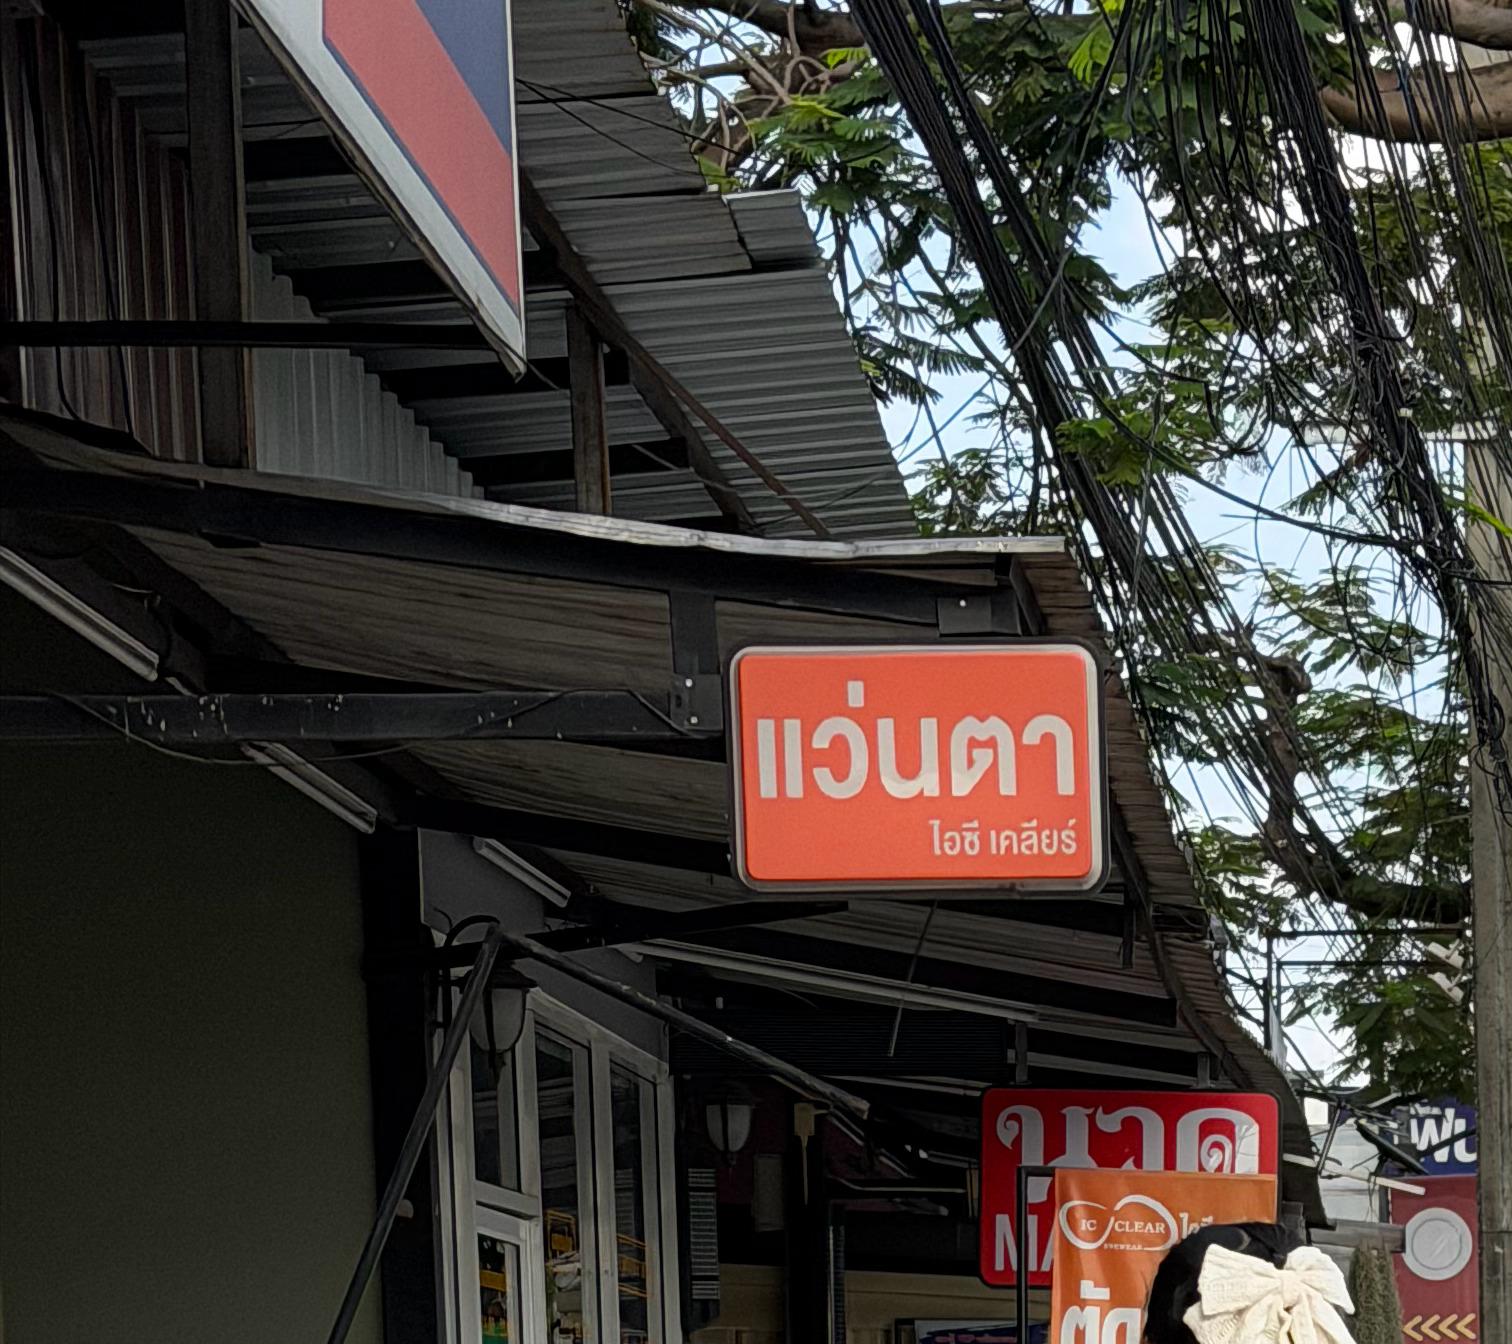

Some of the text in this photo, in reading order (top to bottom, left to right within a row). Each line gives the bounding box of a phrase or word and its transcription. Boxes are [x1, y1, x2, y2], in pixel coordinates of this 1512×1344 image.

[757, 680, 1075, 799] แว่นตา
[929, 818, 1077, 855] ไอซี เคลียร์
[1080, 1219, 1165, 1233] IC CLEAR
